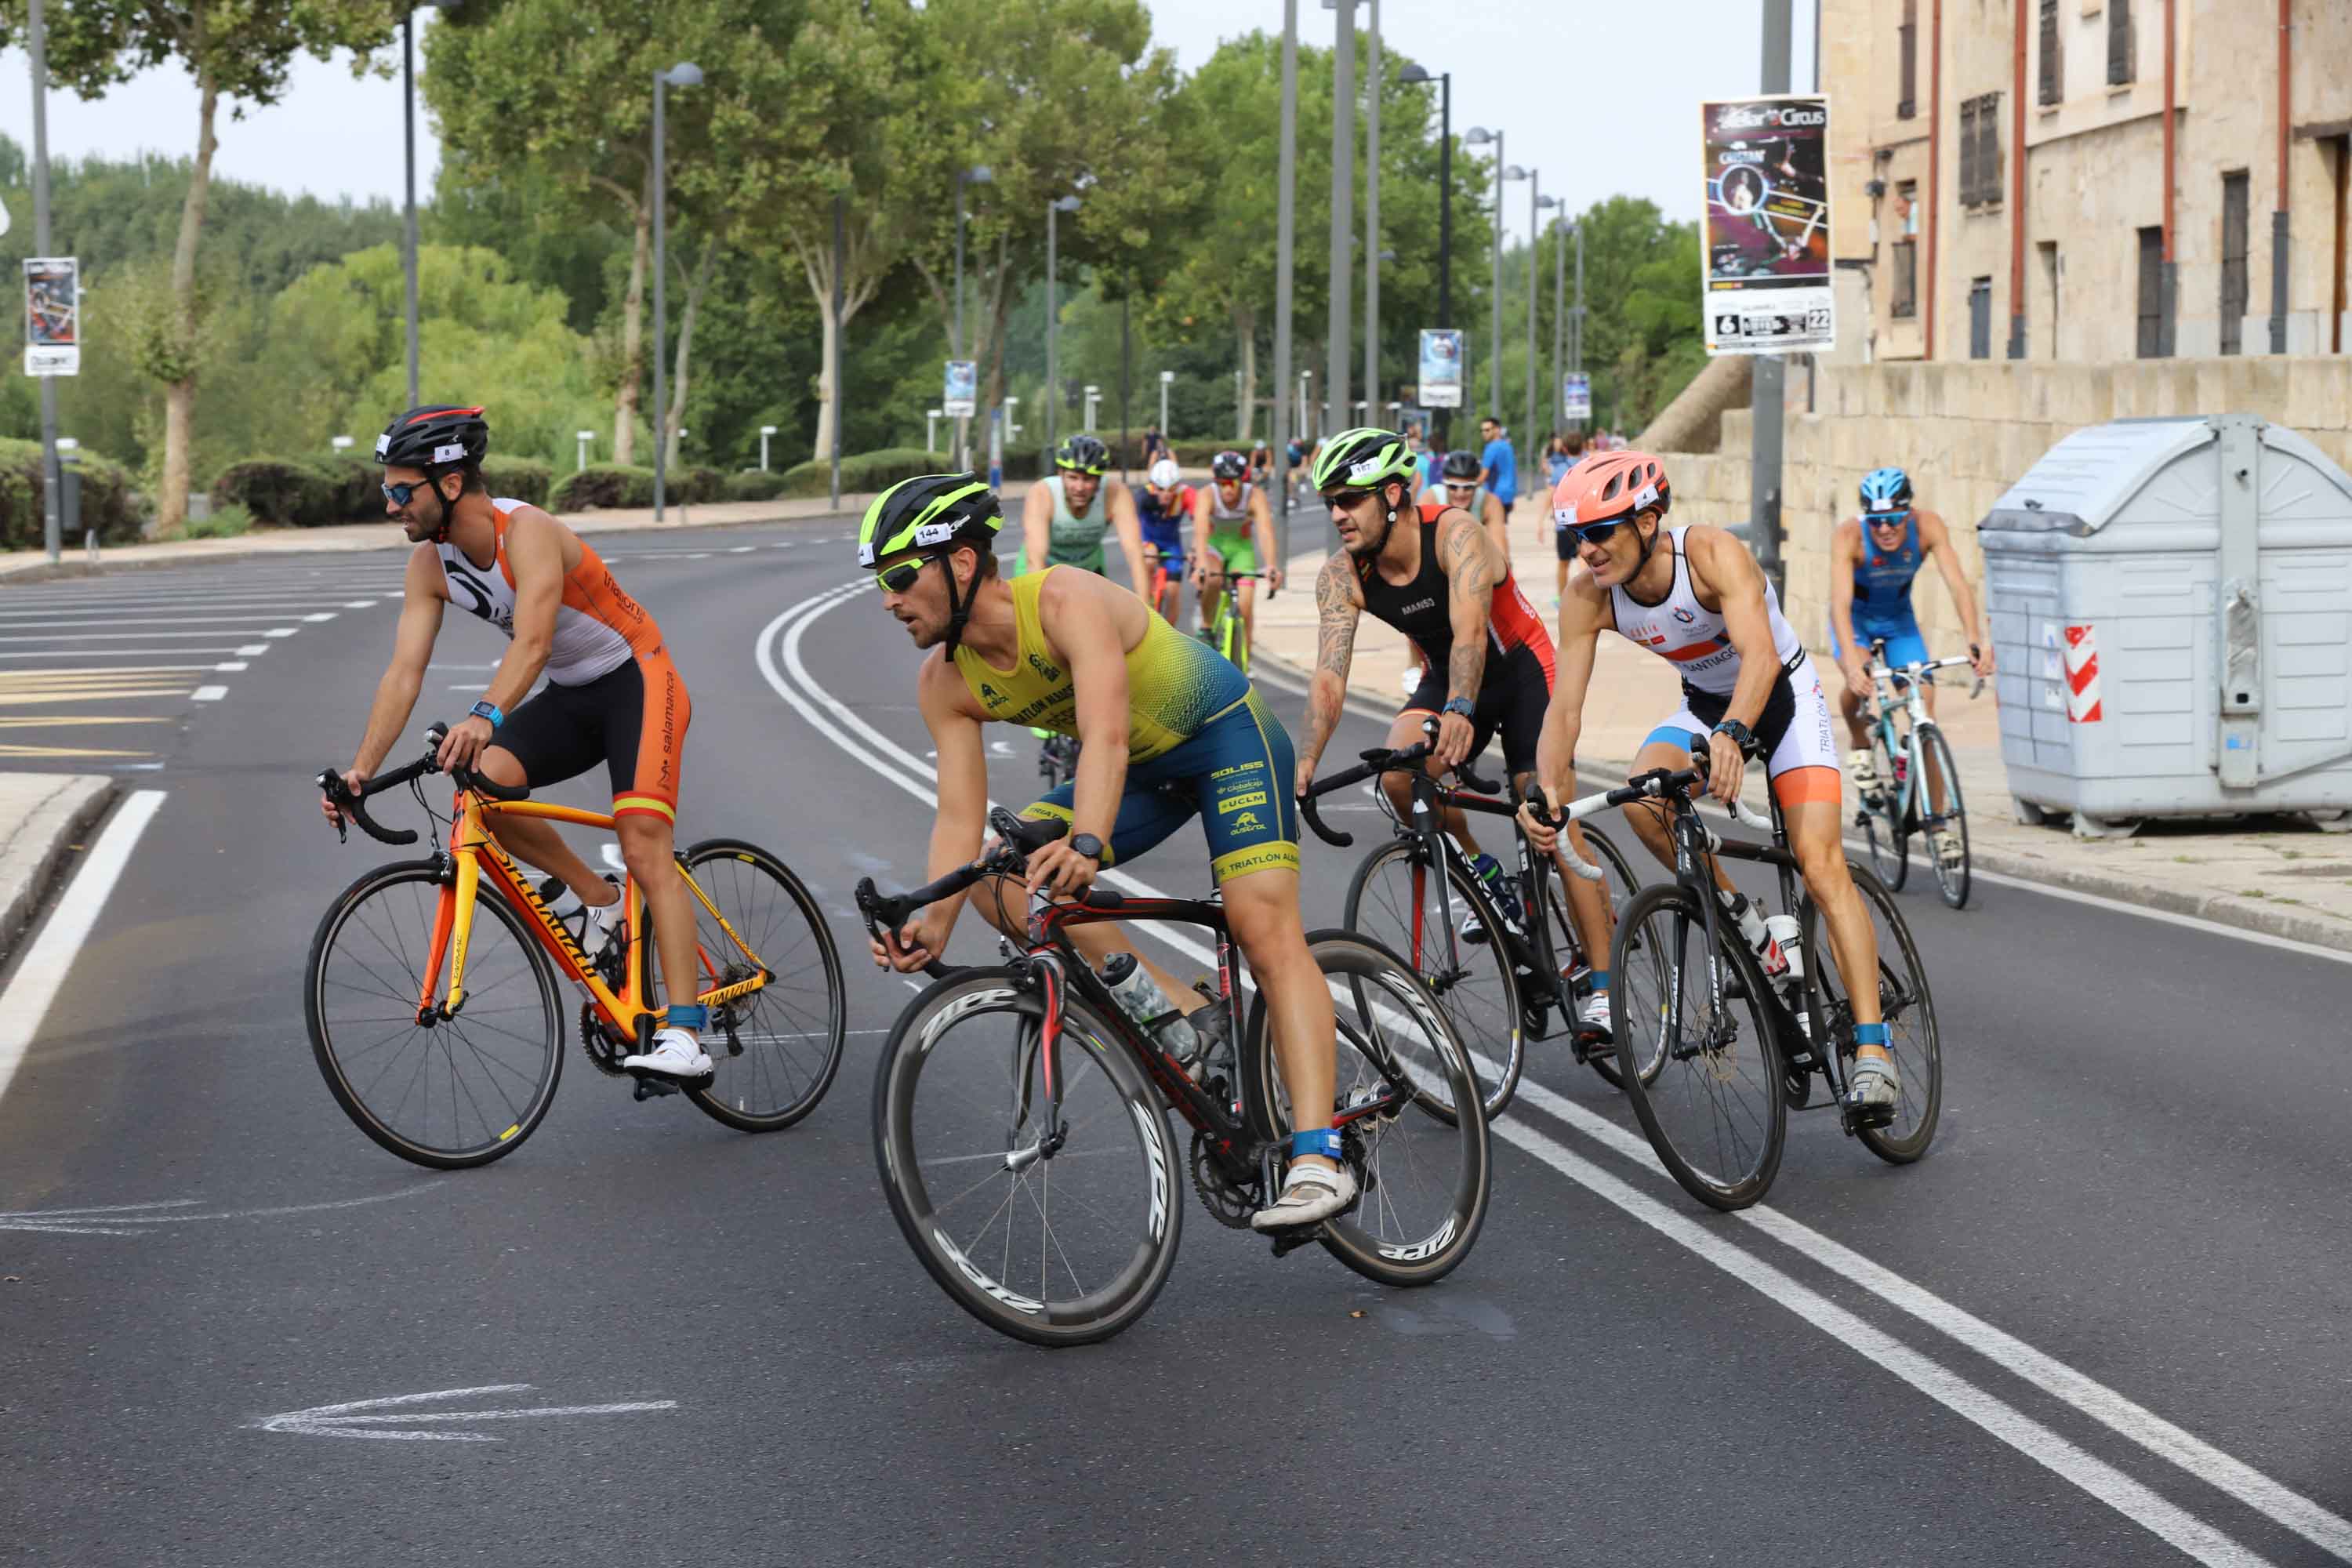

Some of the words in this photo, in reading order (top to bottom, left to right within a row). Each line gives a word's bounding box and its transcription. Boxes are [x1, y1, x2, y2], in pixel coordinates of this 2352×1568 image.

[1781, 108, 1825, 126] Circus
[1719, 314, 1736, 335] 6
[1809, 310, 1830, 328] 22
[920, 527, 939, 539] 144
[1401, 597, 1436, 615] MANSO
[1210, 760, 1265, 779] SOLISS
[1229, 794, 1264, 808] UCLM
[452, 934, 463, 979] TARMAC
[1378, 1217, 1456, 1261] ZIPP
